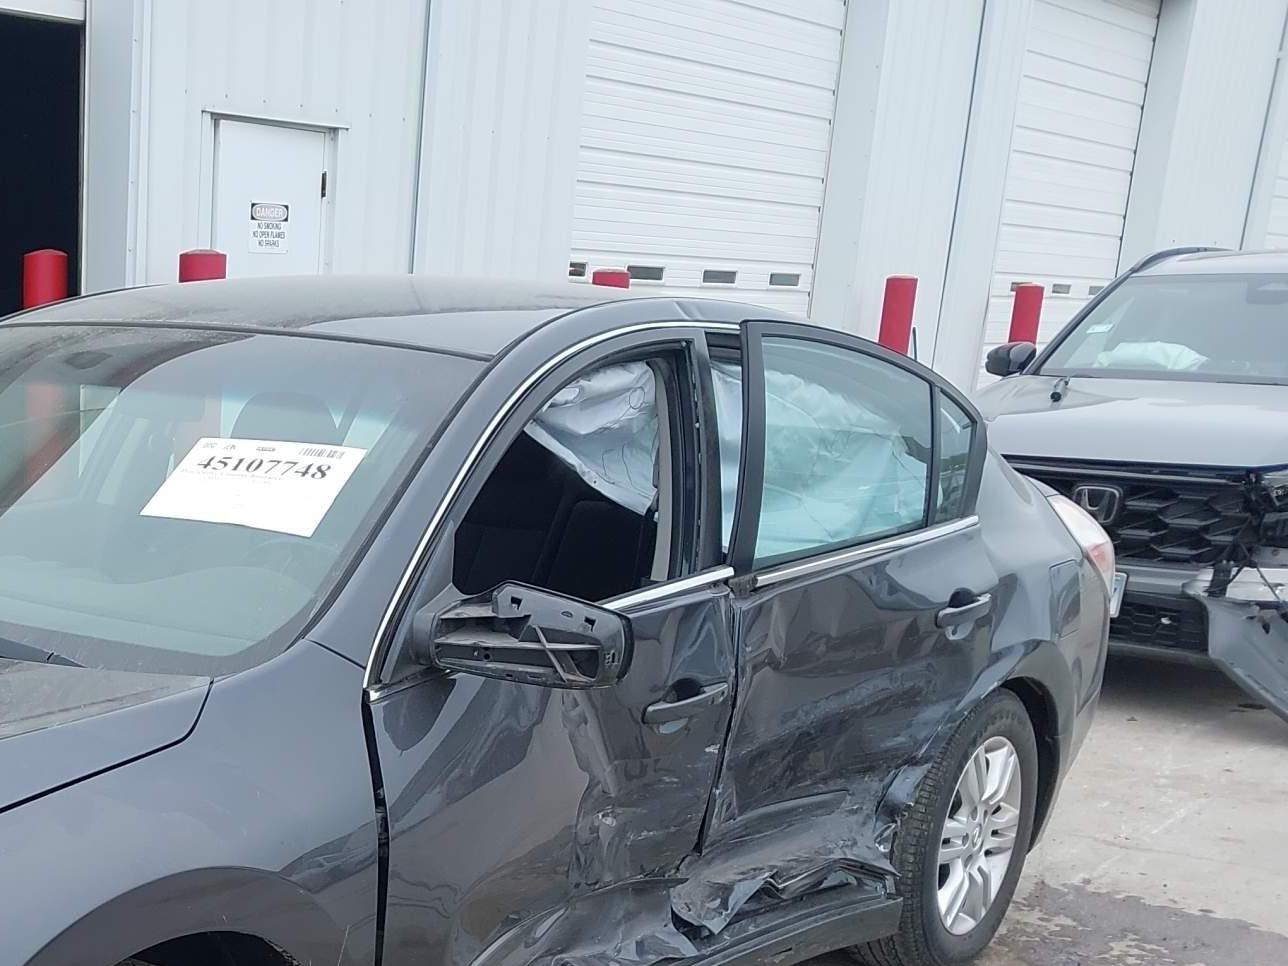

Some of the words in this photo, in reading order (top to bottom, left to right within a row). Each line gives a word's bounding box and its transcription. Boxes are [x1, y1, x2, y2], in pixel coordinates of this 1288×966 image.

[256, 207, 283, 217] DANGER
[264, 222, 282, 230] SMOKING
[259, 230, 270, 239] OPEN
[196, 455, 332, 480] 45107748
